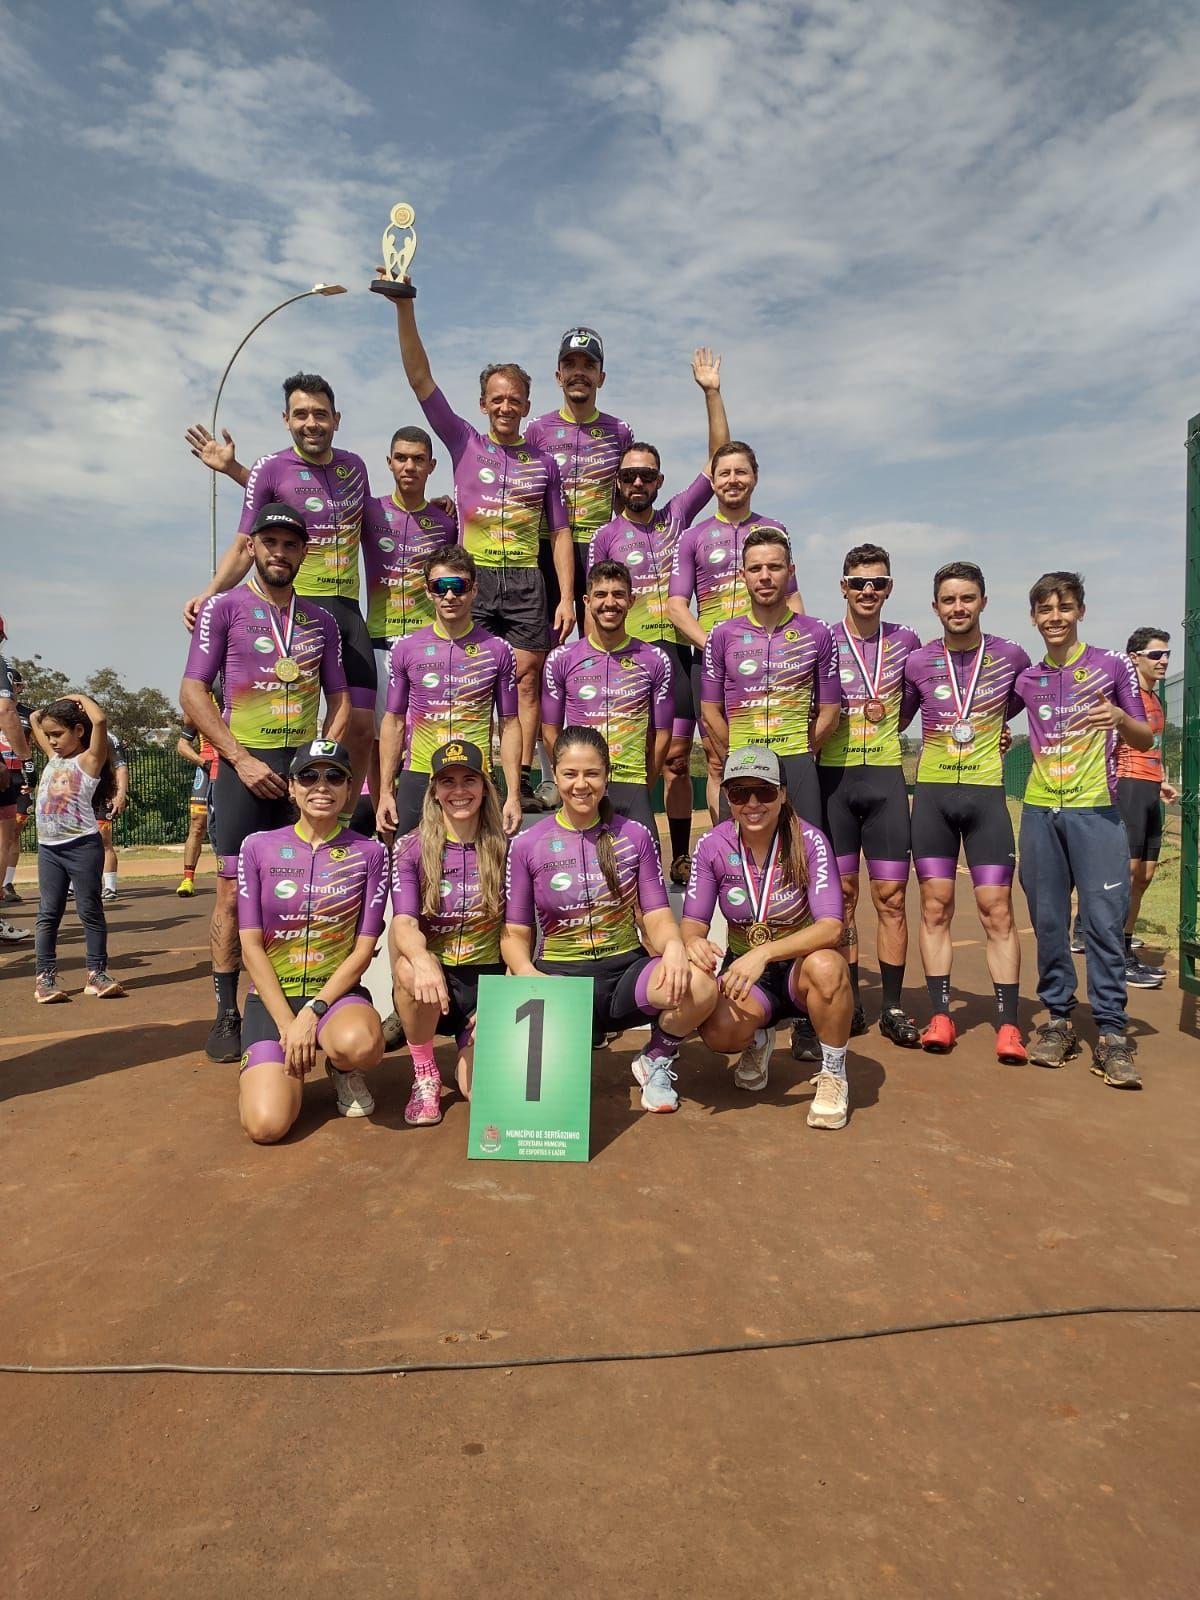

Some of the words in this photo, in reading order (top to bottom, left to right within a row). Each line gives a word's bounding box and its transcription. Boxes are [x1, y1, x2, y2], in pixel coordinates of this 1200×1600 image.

[245, 453, 277, 510] ARRIVAL
[199, 592, 228, 654] ARRIVAL
[545, 645, 571, 700] ARRIVAL
[651, 646, 671, 705] ARRIVAL
[761, 660, 800, 670] Stratus
[1104, 650, 1139, 698] ARRIVAL
[1055, 702, 1090, 715] Stratus
[457, 882, 480, 892] Stra
[802, 829, 829, 895] ARRIVAL
[302, 883, 347, 894] Stratus
[515, 998, 545, 1101] 1
[535, 1130, 543, 1138] DE
